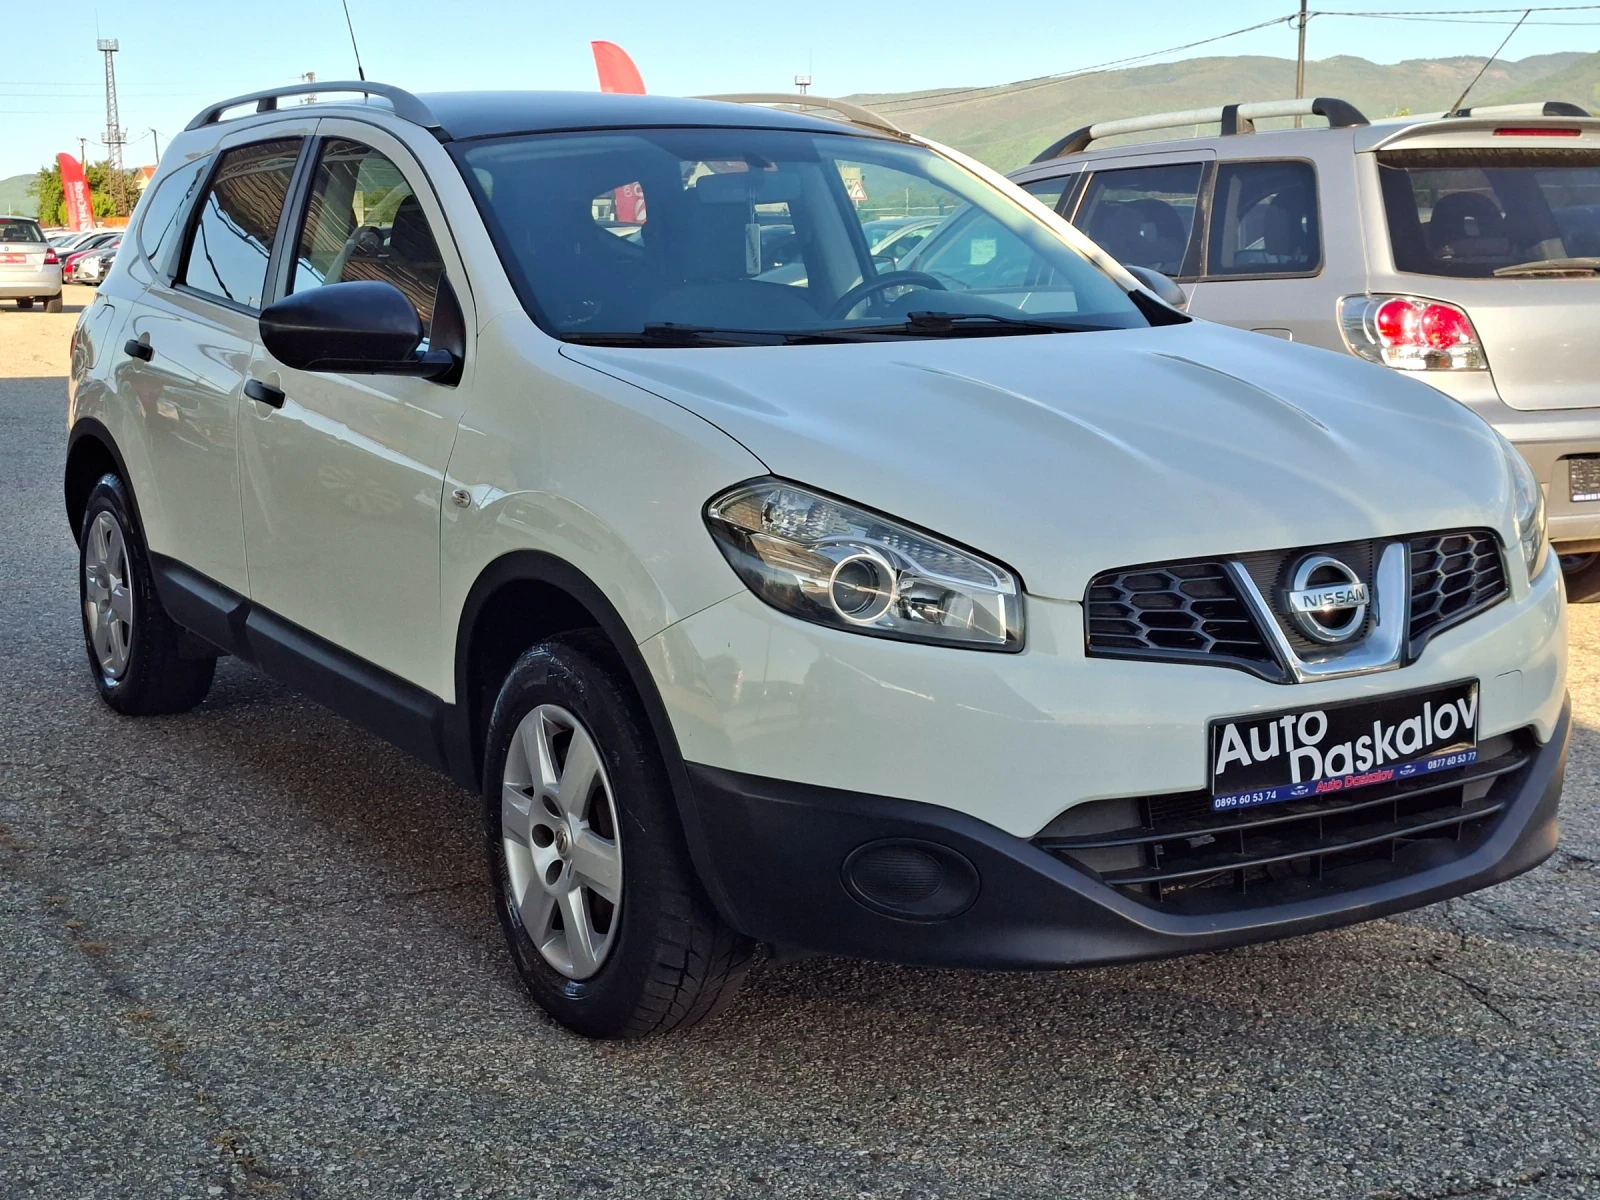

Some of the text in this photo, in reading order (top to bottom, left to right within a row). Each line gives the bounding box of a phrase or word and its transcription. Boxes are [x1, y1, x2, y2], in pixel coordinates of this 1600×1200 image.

[1303, 587, 1365, 608] NISSAN
[1215, 710, 1328, 775] Auto
[1289, 697, 1478, 784] Daskalov
[1428, 751, 1477, 770] 0877 60 53 77
[1315, 769, 1395, 793] Auto Daskalov
[1214, 790, 1277, 808] 0895 60 53 74
